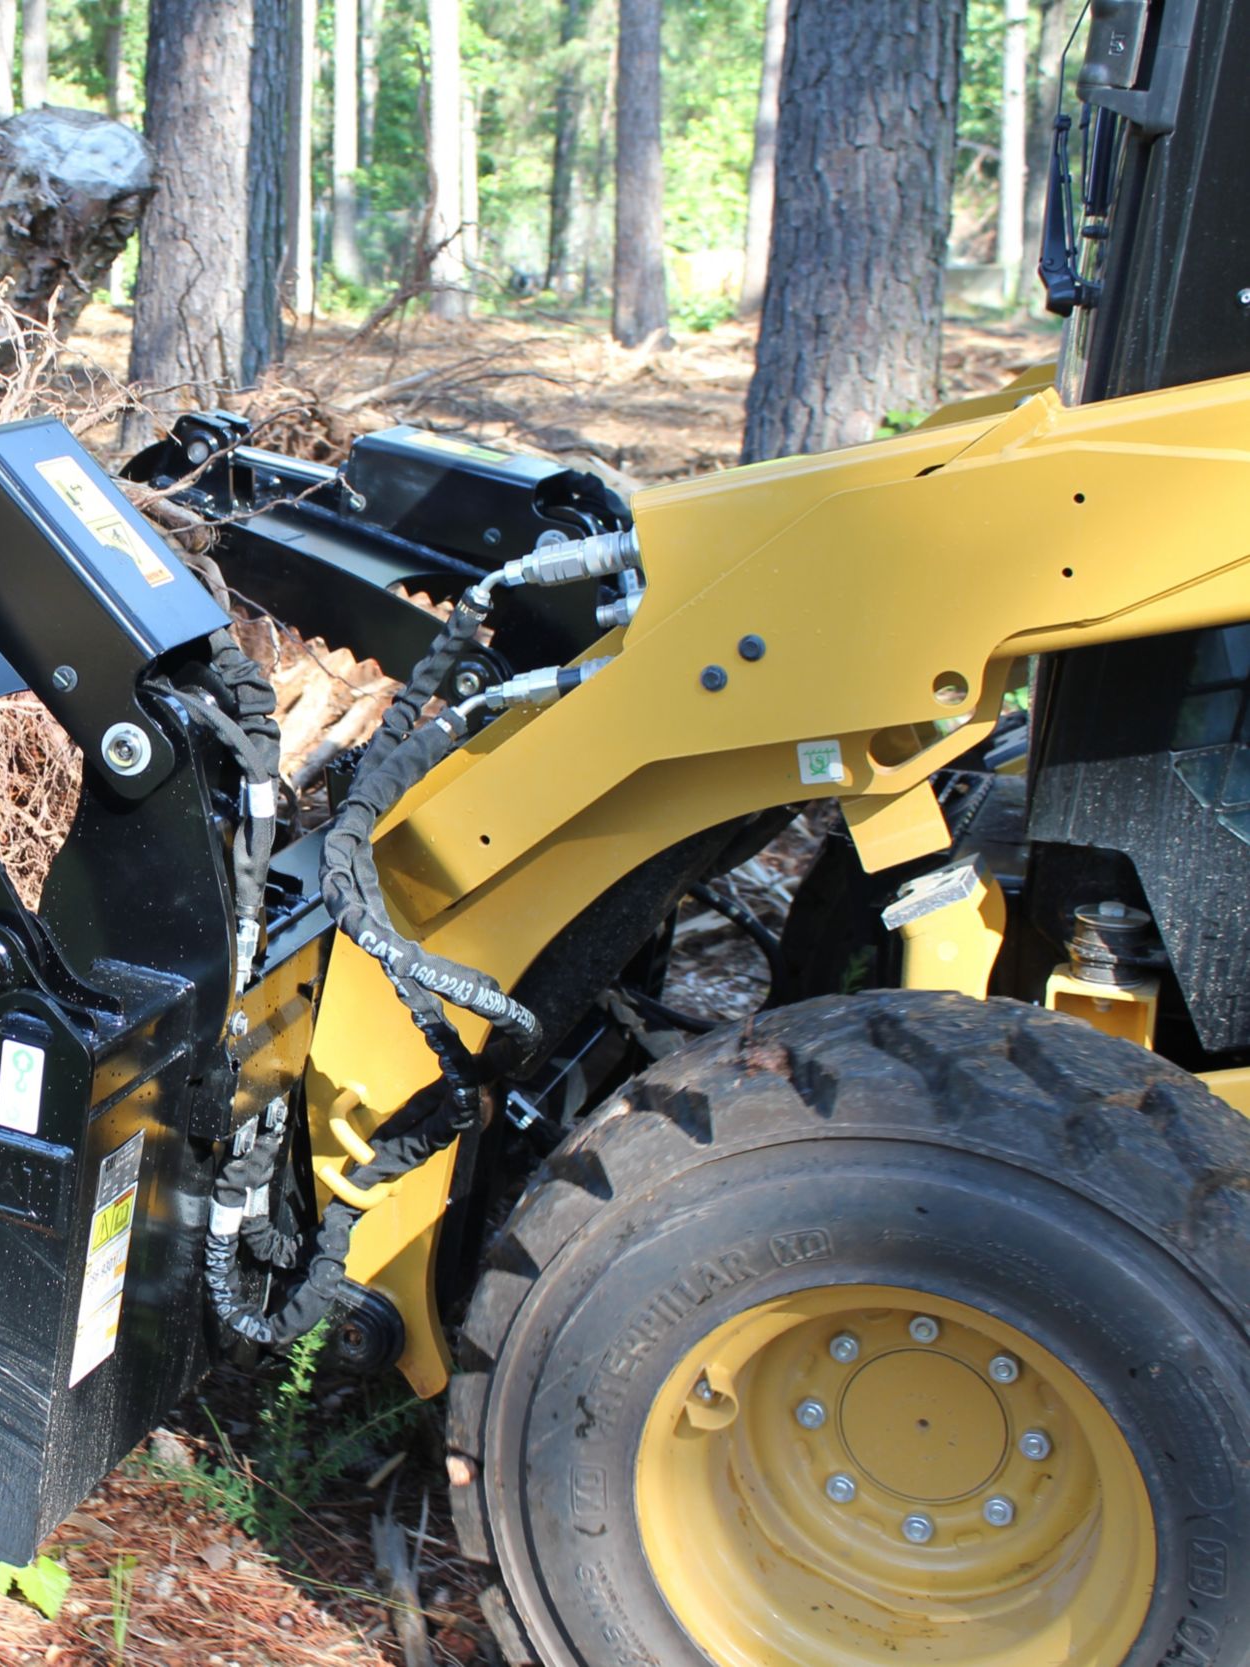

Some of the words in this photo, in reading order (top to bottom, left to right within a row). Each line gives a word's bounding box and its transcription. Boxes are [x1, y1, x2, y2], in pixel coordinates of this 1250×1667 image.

[357, 930, 404, 965] CAT
[408, 961, 474, 1002] 160-2243
[473, 986, 507, 1016] MSHA
[233, 1315, 272, 1343] CAT
